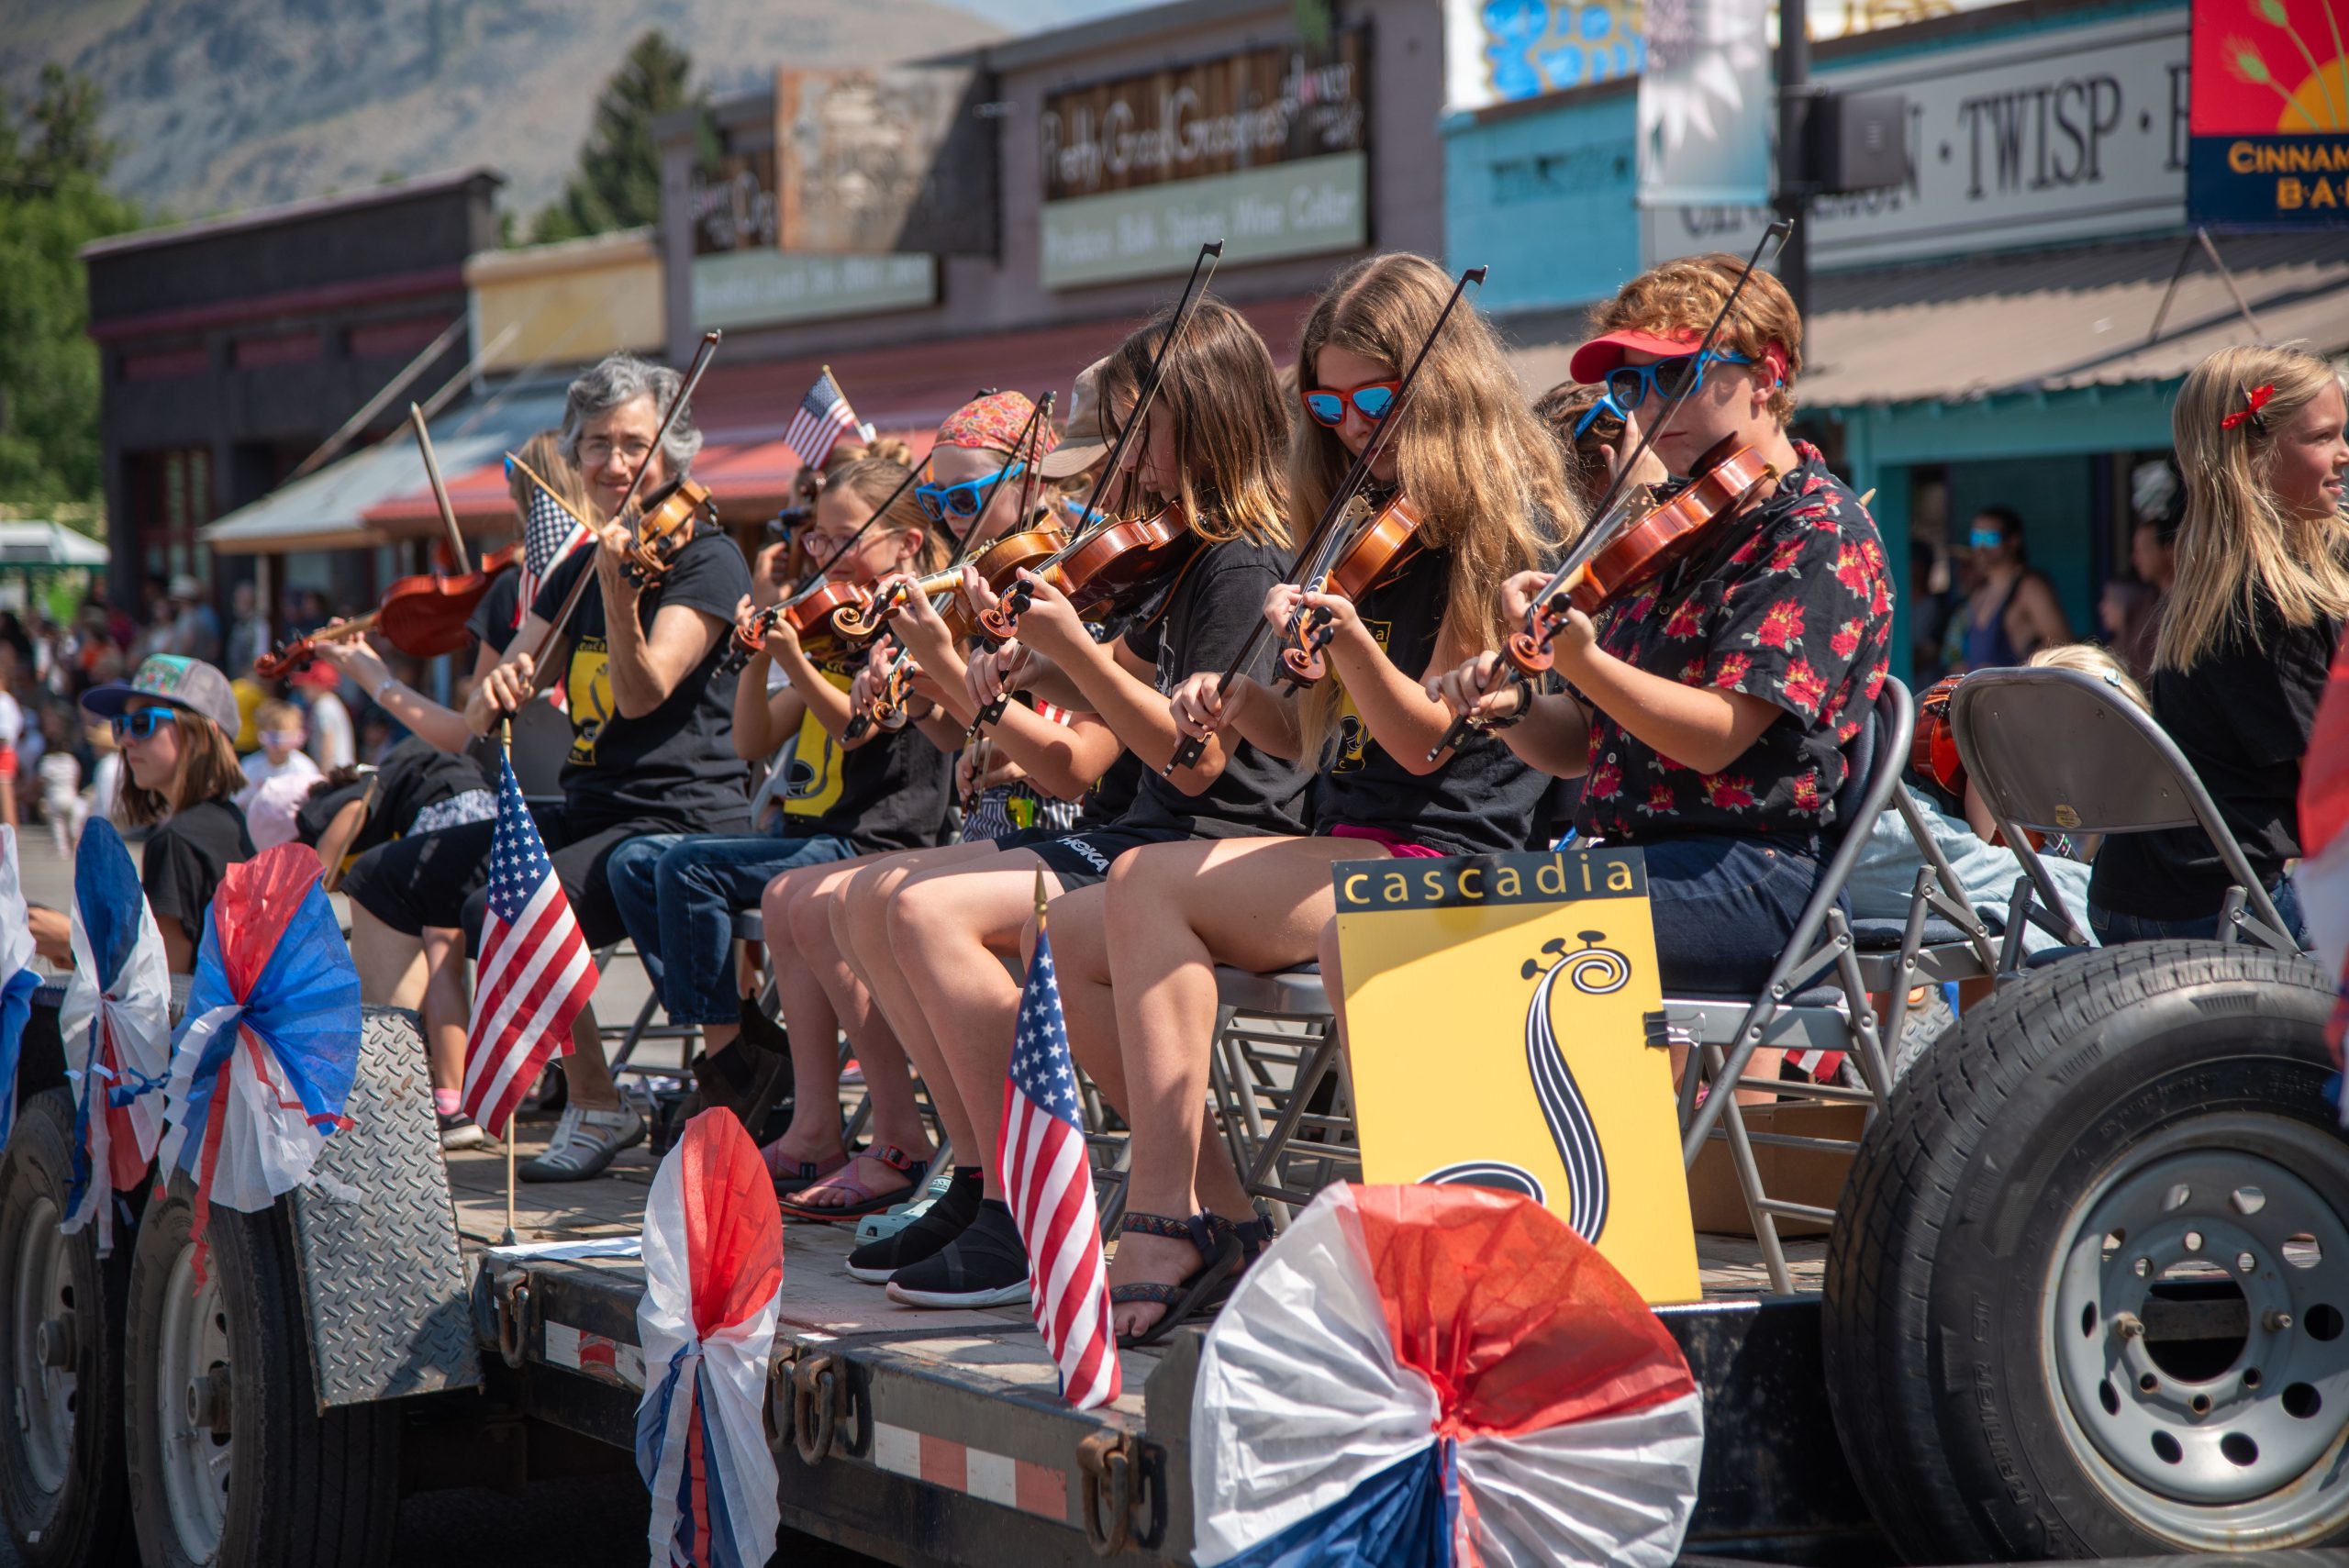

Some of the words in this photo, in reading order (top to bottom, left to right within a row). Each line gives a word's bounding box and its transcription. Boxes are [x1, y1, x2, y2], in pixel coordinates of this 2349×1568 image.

[1103, 87, 1172, 174] Good
[1958, 73, 2122, 200] TWISP
[1055, 837, 1110, 873] HOKA
[1344, 853, 1633, 905] cascadia
